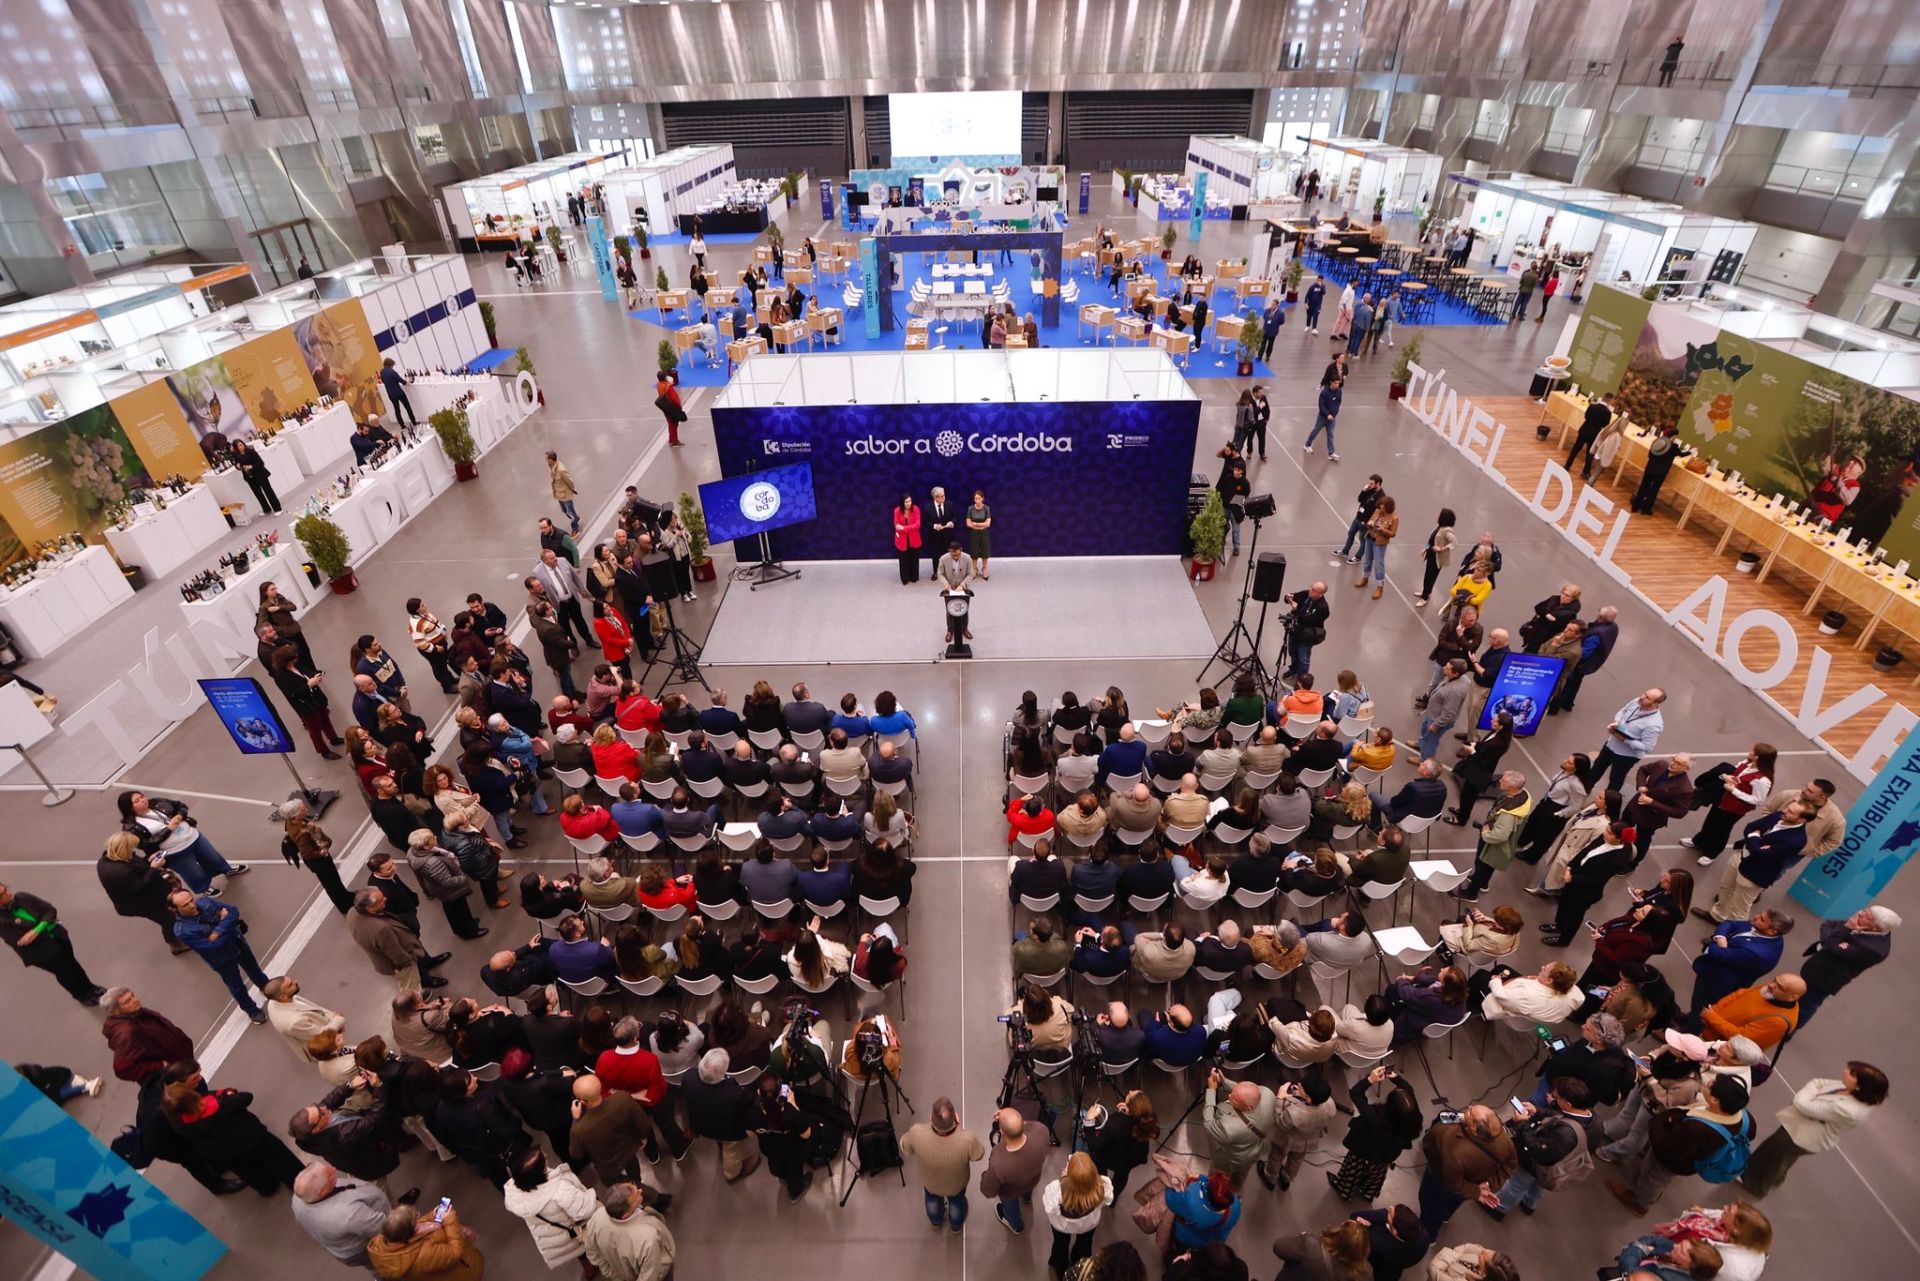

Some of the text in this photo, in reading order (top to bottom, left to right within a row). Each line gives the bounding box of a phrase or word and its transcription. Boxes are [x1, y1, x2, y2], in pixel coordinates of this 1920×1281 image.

[845, 432, 1073, 455] sabor a Córdoba
[1403, 360, 1507, 487] TÚNEL
[1530, 458, 1632, 589] DEL
[1821, 775, 1912, 879] EXHIBICIONES
